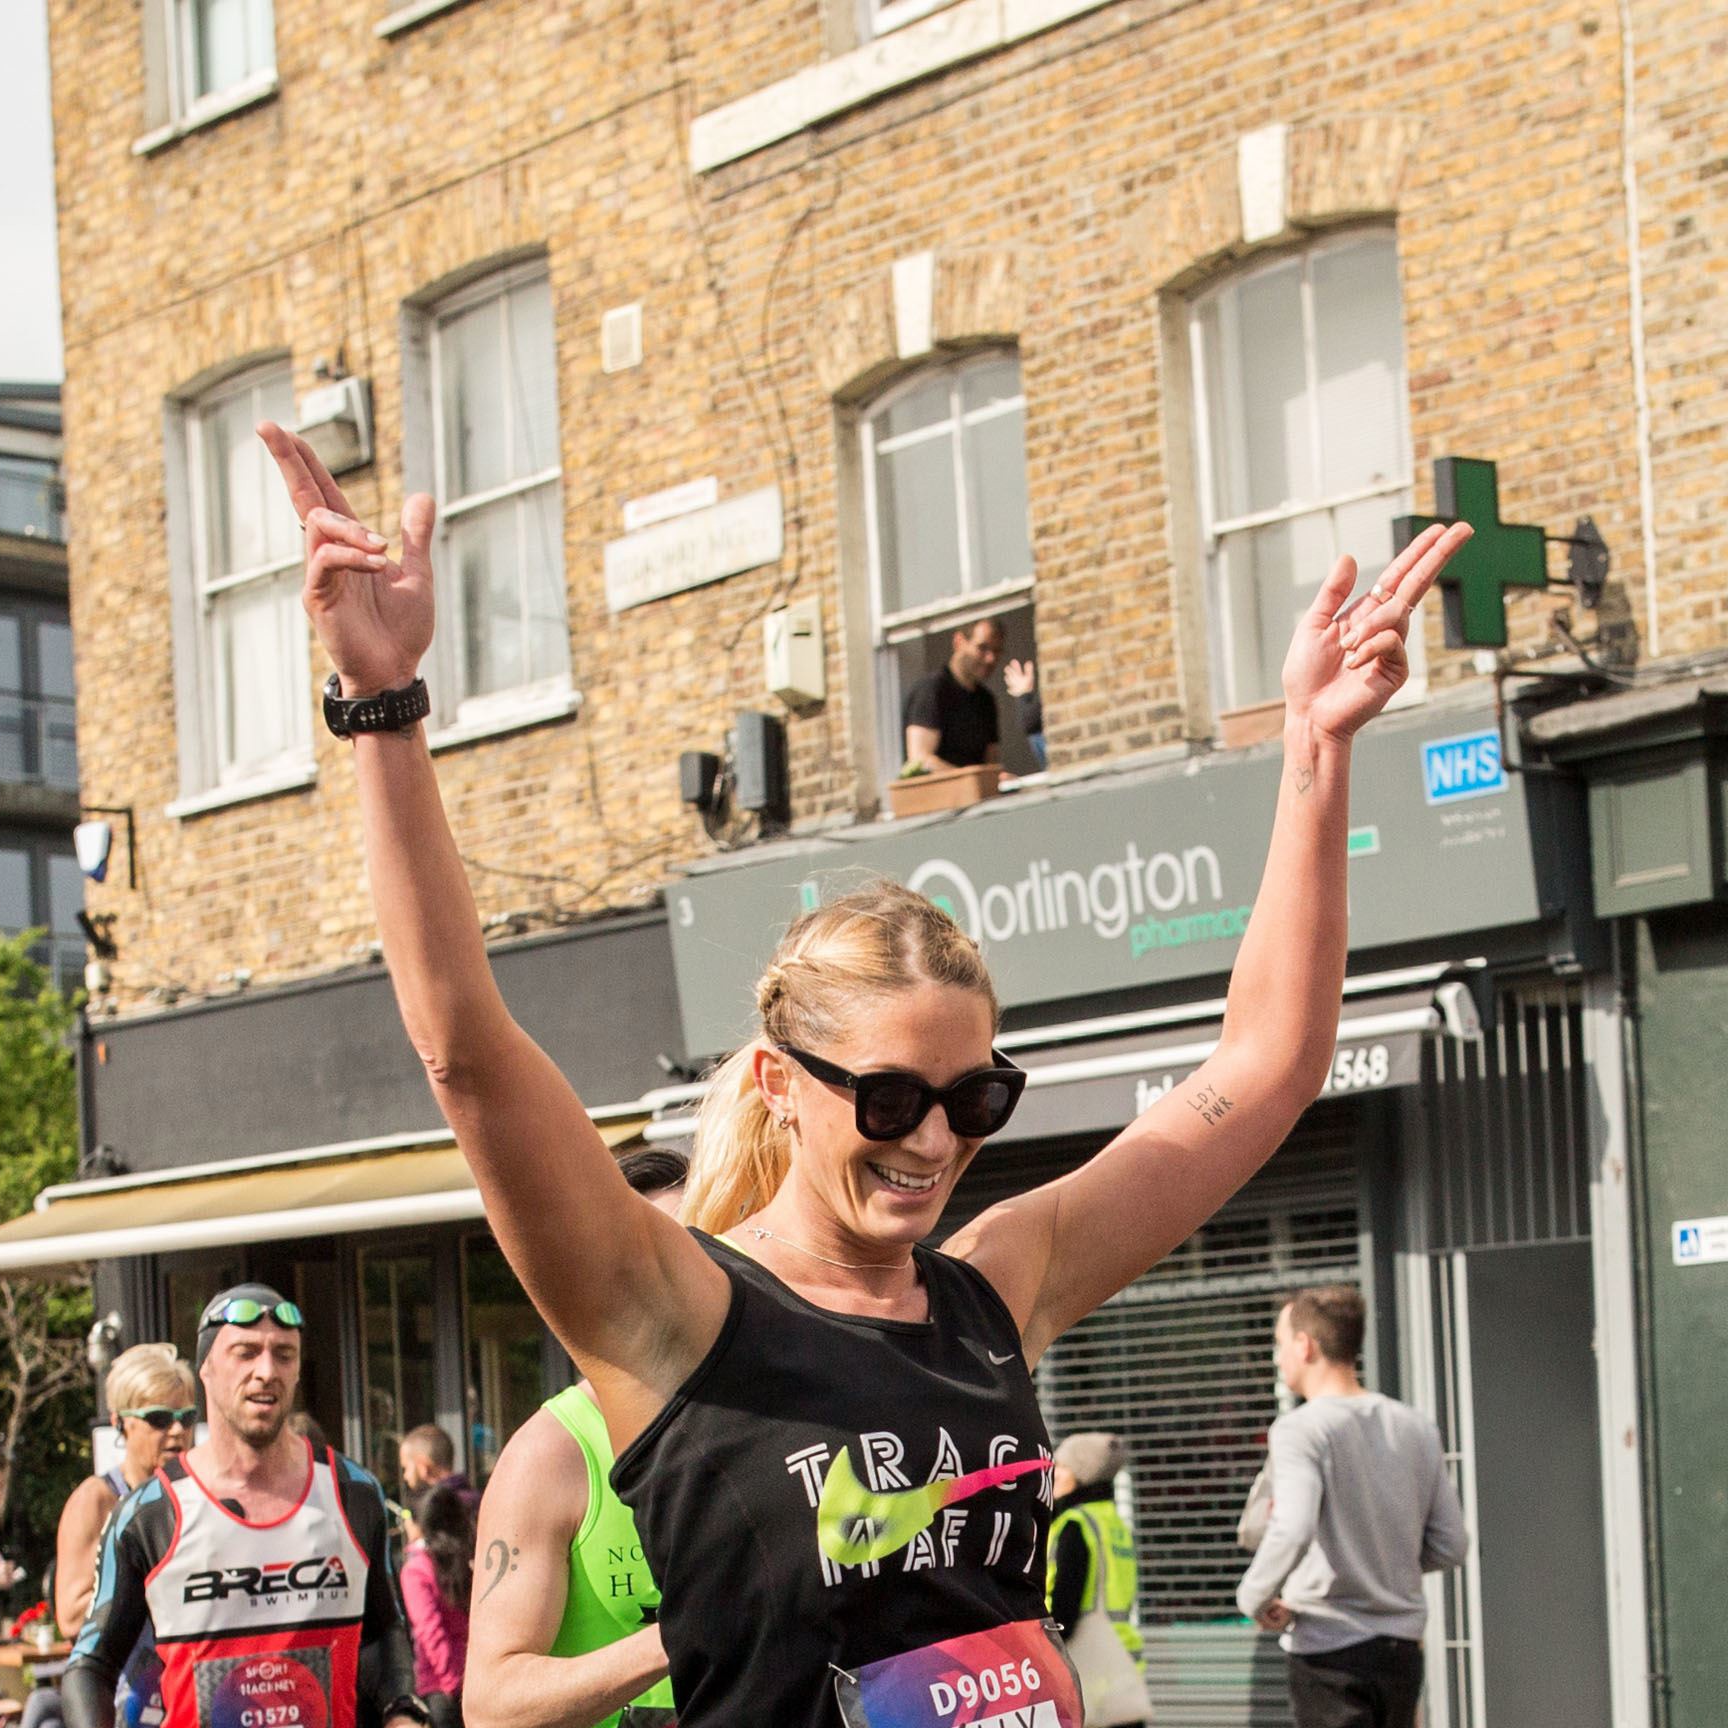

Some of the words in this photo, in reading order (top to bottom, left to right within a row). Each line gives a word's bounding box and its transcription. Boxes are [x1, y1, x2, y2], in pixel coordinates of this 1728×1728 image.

[1431, 741, 1500, 791] NHS
[678, 896, 695, 927] 3
[1129, 904, 1253, 962] pharmac
[1186, 1083, 1218, 1112] LDY
[1201, 1095, 1235, 1127] PWR
[784, 1426, 1055, 1512] TRACK
[183, 1555, 349, 1604] BRECA
[240, 1678, 296, 1696] HACKNEY
[929, 1657, 1041, 1717] D9056
[240, 1705, 300, 1727] C1579
